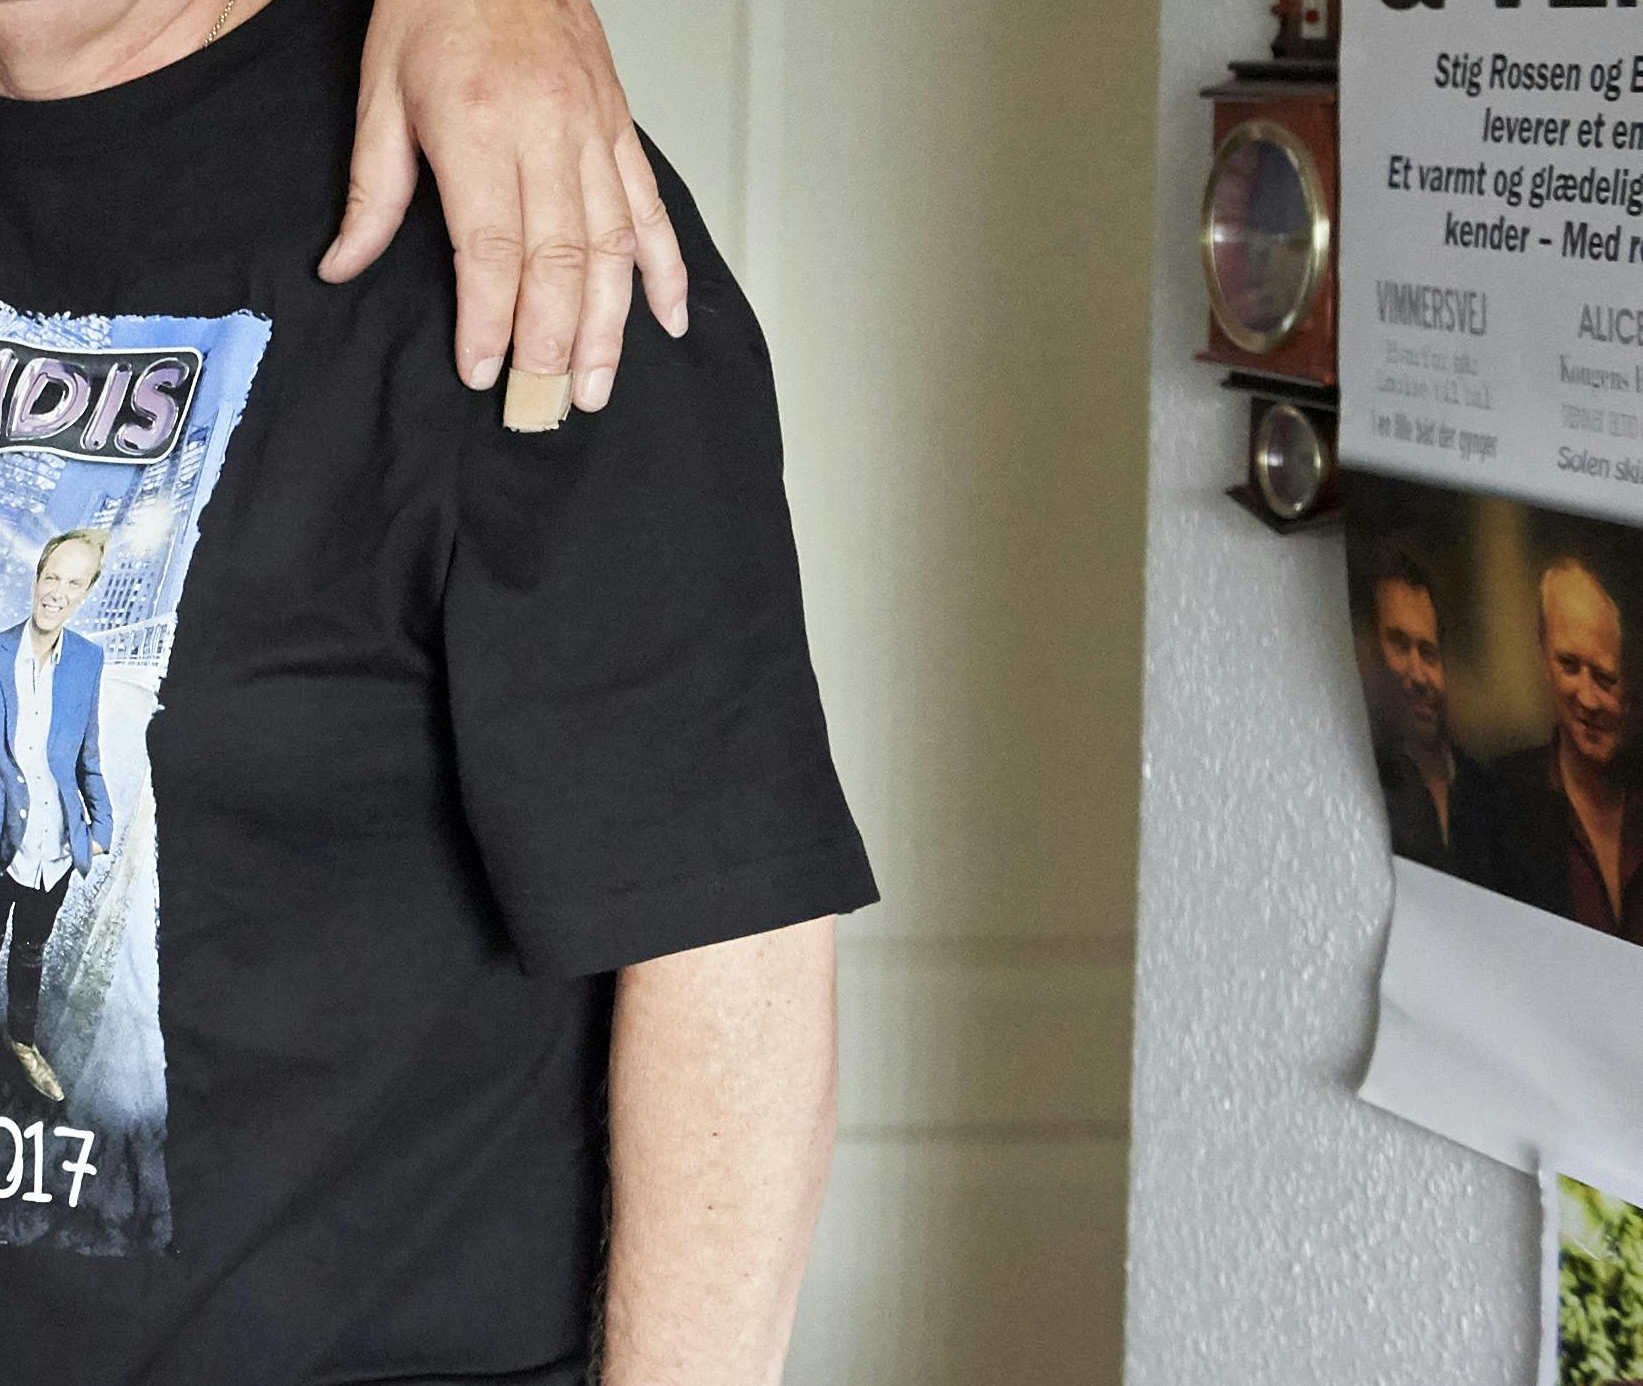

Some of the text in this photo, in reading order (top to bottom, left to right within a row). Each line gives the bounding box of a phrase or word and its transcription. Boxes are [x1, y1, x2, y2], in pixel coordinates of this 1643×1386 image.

[1434, 52, 1484, 97] Stig
[1489, 52, 1582, 92] Rossen
[1590, 58, 1623, 102] og
[1482, 107, 1571, 147] leverer
[1577, 112, 1607, 149] et
[1387, 154, 1414, 191] Et
[1418, 161, 1488, 197] varmt
[1493, 165, 1525, 208] og
[1444, 210, 1531, 254] kender
[1561, 220, 1622, 264] Med
[1557, 444, 1612, 480] Solen
